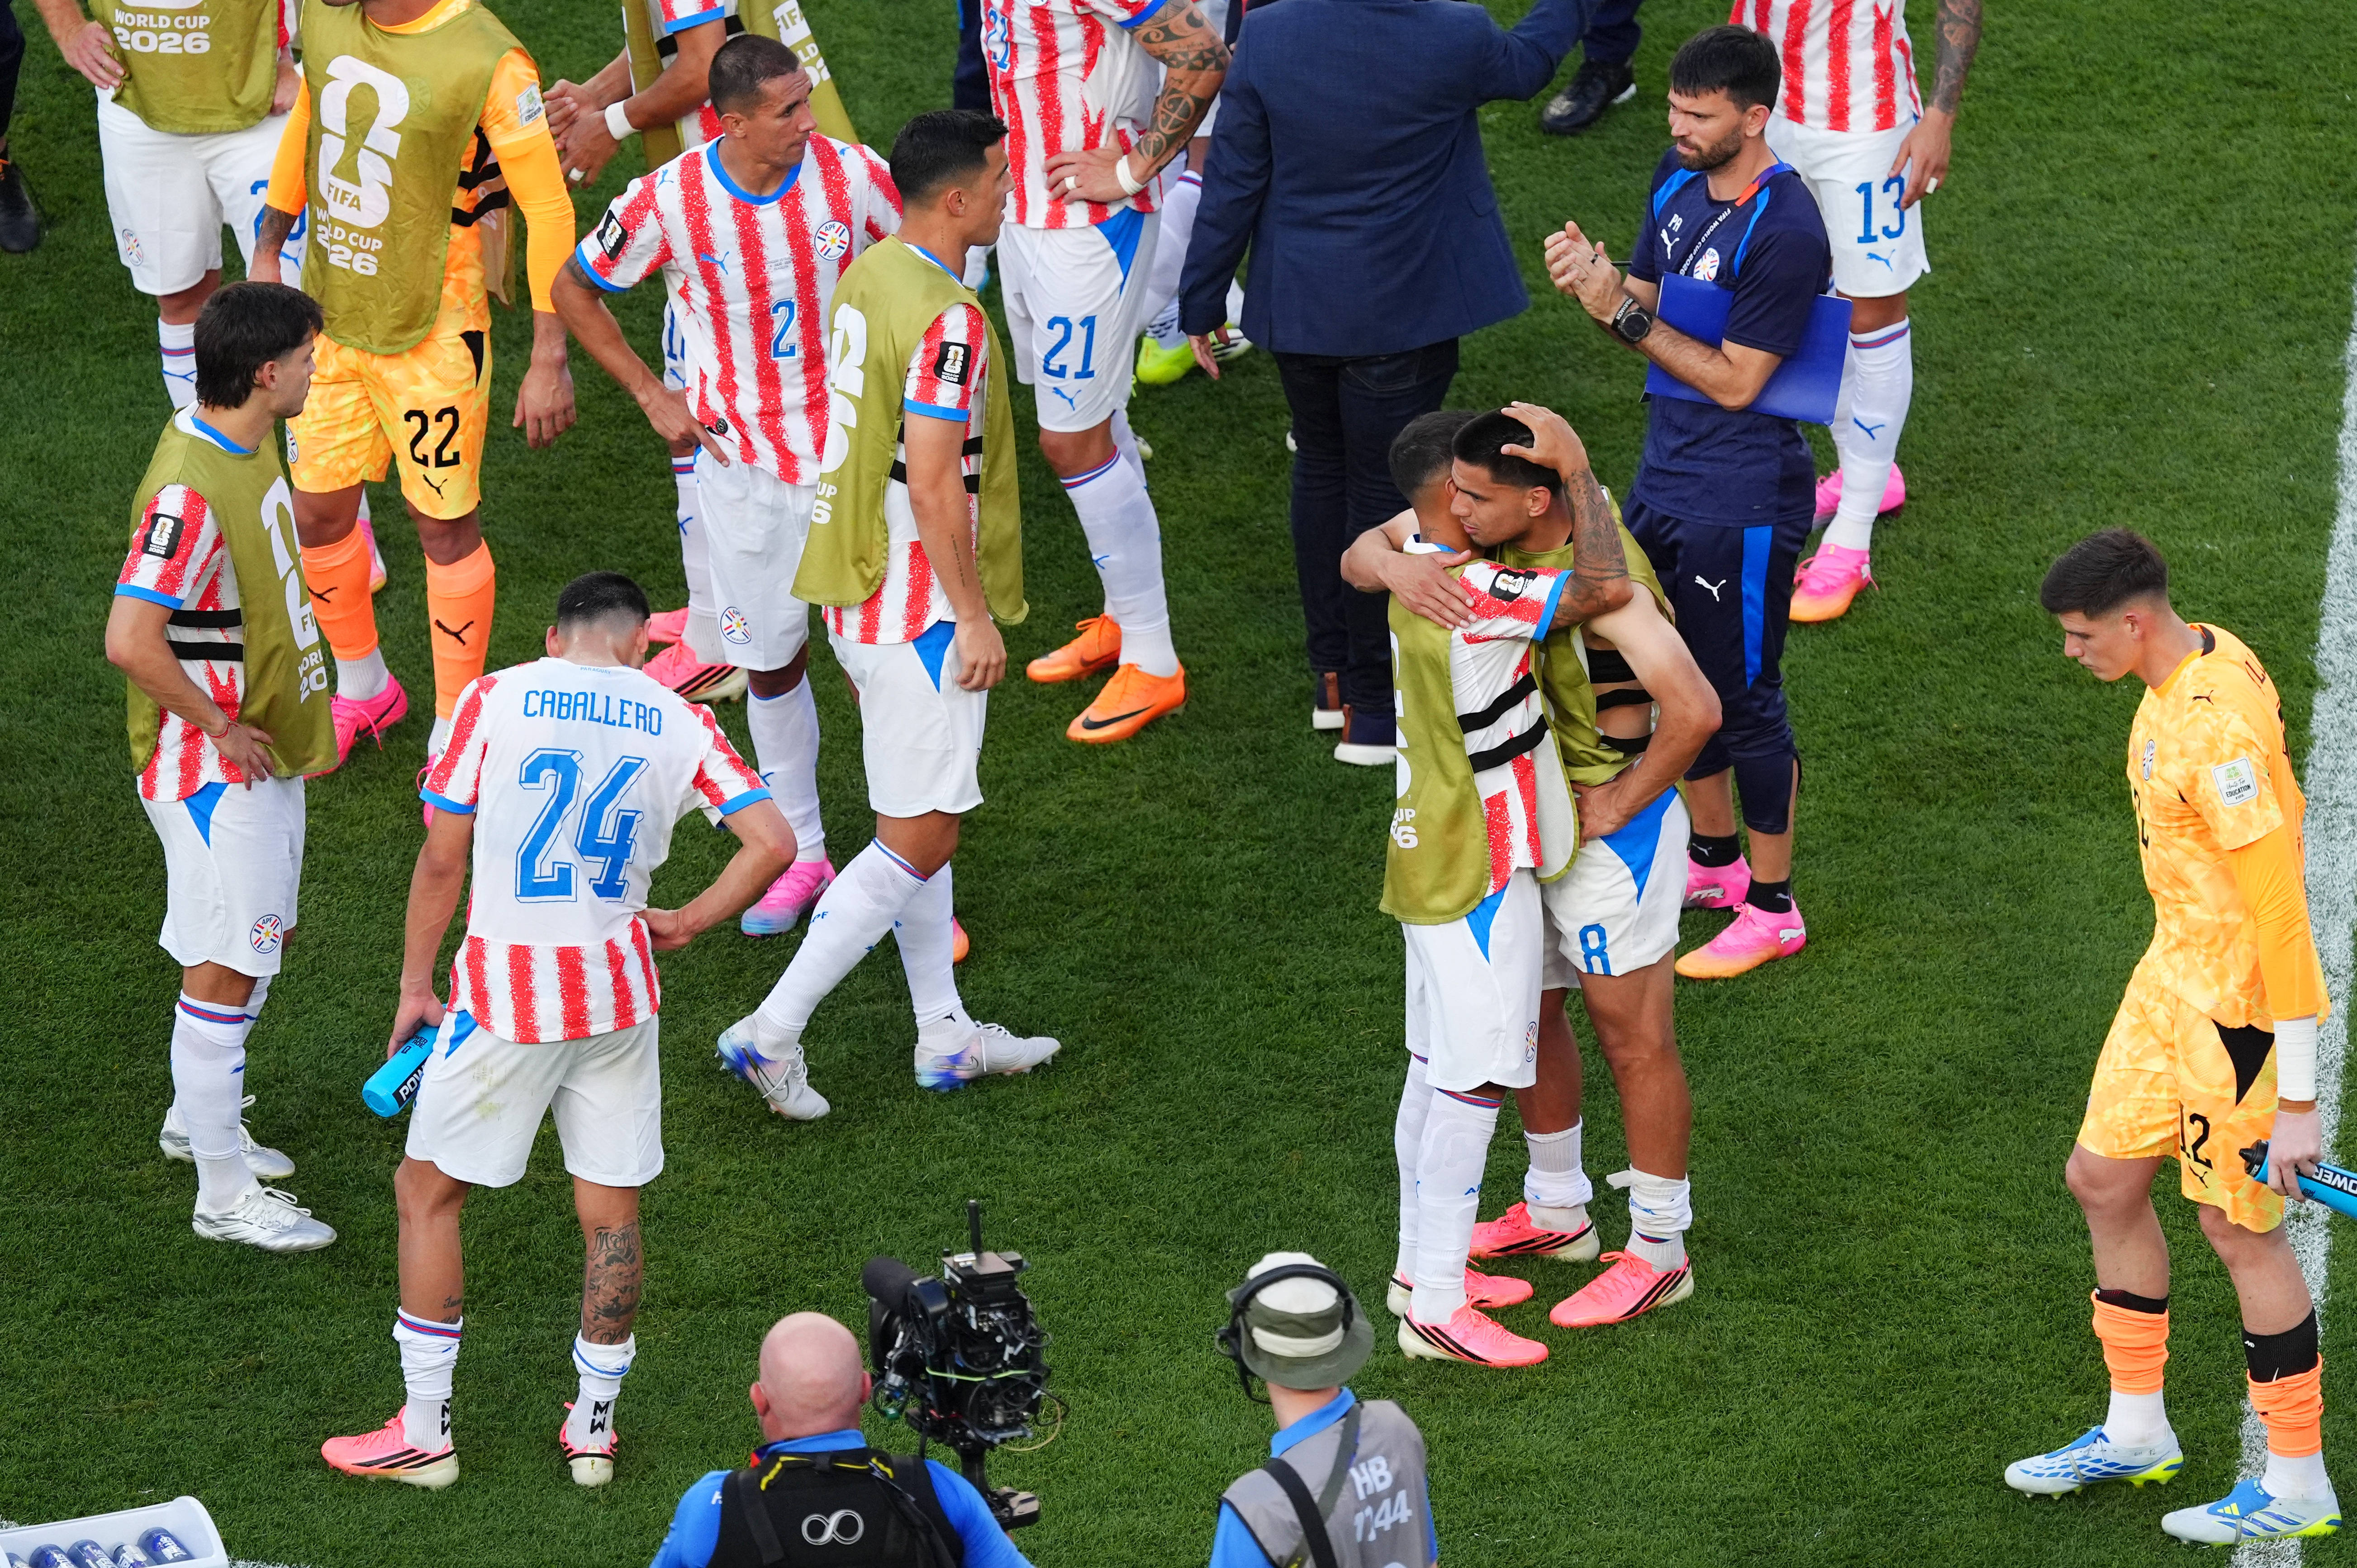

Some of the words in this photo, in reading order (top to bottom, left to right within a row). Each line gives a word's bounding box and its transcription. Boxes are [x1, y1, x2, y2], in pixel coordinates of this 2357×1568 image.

[115, 8, 171, 29] WORLD
[174, 15, 210, 29] CUP
[112, 26, 210, 54] 2026
[328, 182, 361, 212] FIFA
[1856, 176, 1905, 243] 13
[824, 223, 836, 232] APF
[1668, 214, 1683, 232] PA
[1718, 208, 1731, 222] FIFA
[348, 232, 383, 252] CUP
[1701, 220, 1719, 243] WORLD
[1692, 241, 1703, 254] CUP
[1679, 253, 1693, 276] 2026
[770, 297, 799, 361] 2
[1043, 315, 1098, 380] 21
[404, 405, 460, 468] 22
[523, 690, 662, 736] CABALLERO
[2226, 784, 2252, 798] EDUCATION
[515, 747, 650, 903] 24
[262, 917, 273, 925] APF
[1578, 923, 1612, 975] 8
[1350, 1456, 1393, 1501] HB
